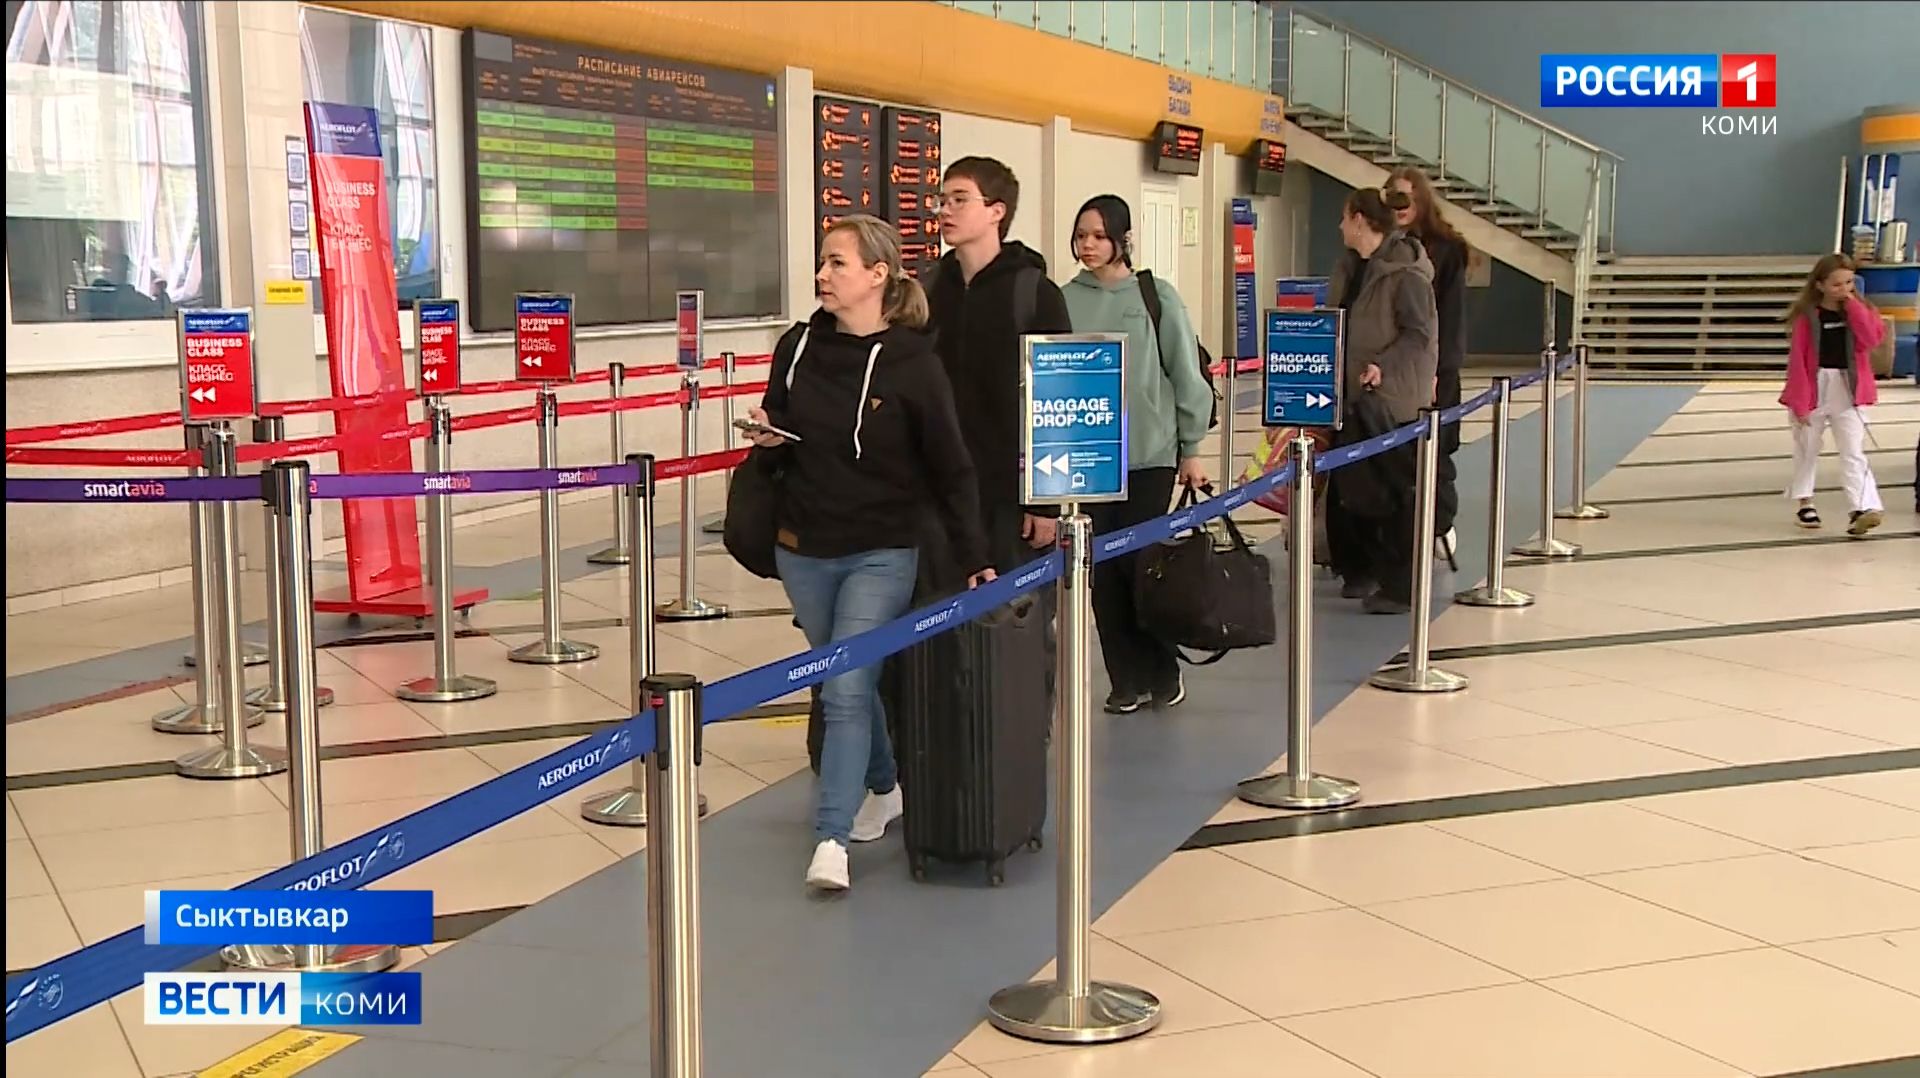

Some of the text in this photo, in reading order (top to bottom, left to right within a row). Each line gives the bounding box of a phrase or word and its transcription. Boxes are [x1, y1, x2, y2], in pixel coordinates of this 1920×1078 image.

[578, 56, 642, 78] РАСПИСАНИЕ
[327, 181, 376, 196] BUSINESS
[327, 196, 361, 210] CLASS
[520, 318, 565, 326] BUSINESS
[187, 338, 243, 348] BUSINESS
[187, 347, 224, 357] CLASS
[1037, 352, 1087, 362] AEROFLOT
[1270, 353, 1328, 364] BAGGAGE
[1270, 363, 1333, 374] DROP-OFF
[1033, 398, 1109, 414] BAGGAGE
[1033, 412, 1114, 428] DROP-OFF
[424, 474, 471, 490] smartavia
[558, 469, 598, 484] smartavia
[84, 480, 166, 498] smartavia
[914, 610, 949, 633] AEROFLOT
[787, 656, 831, 683] AEROFLOT
[537, 748, 602, 791] AEROFLOT
